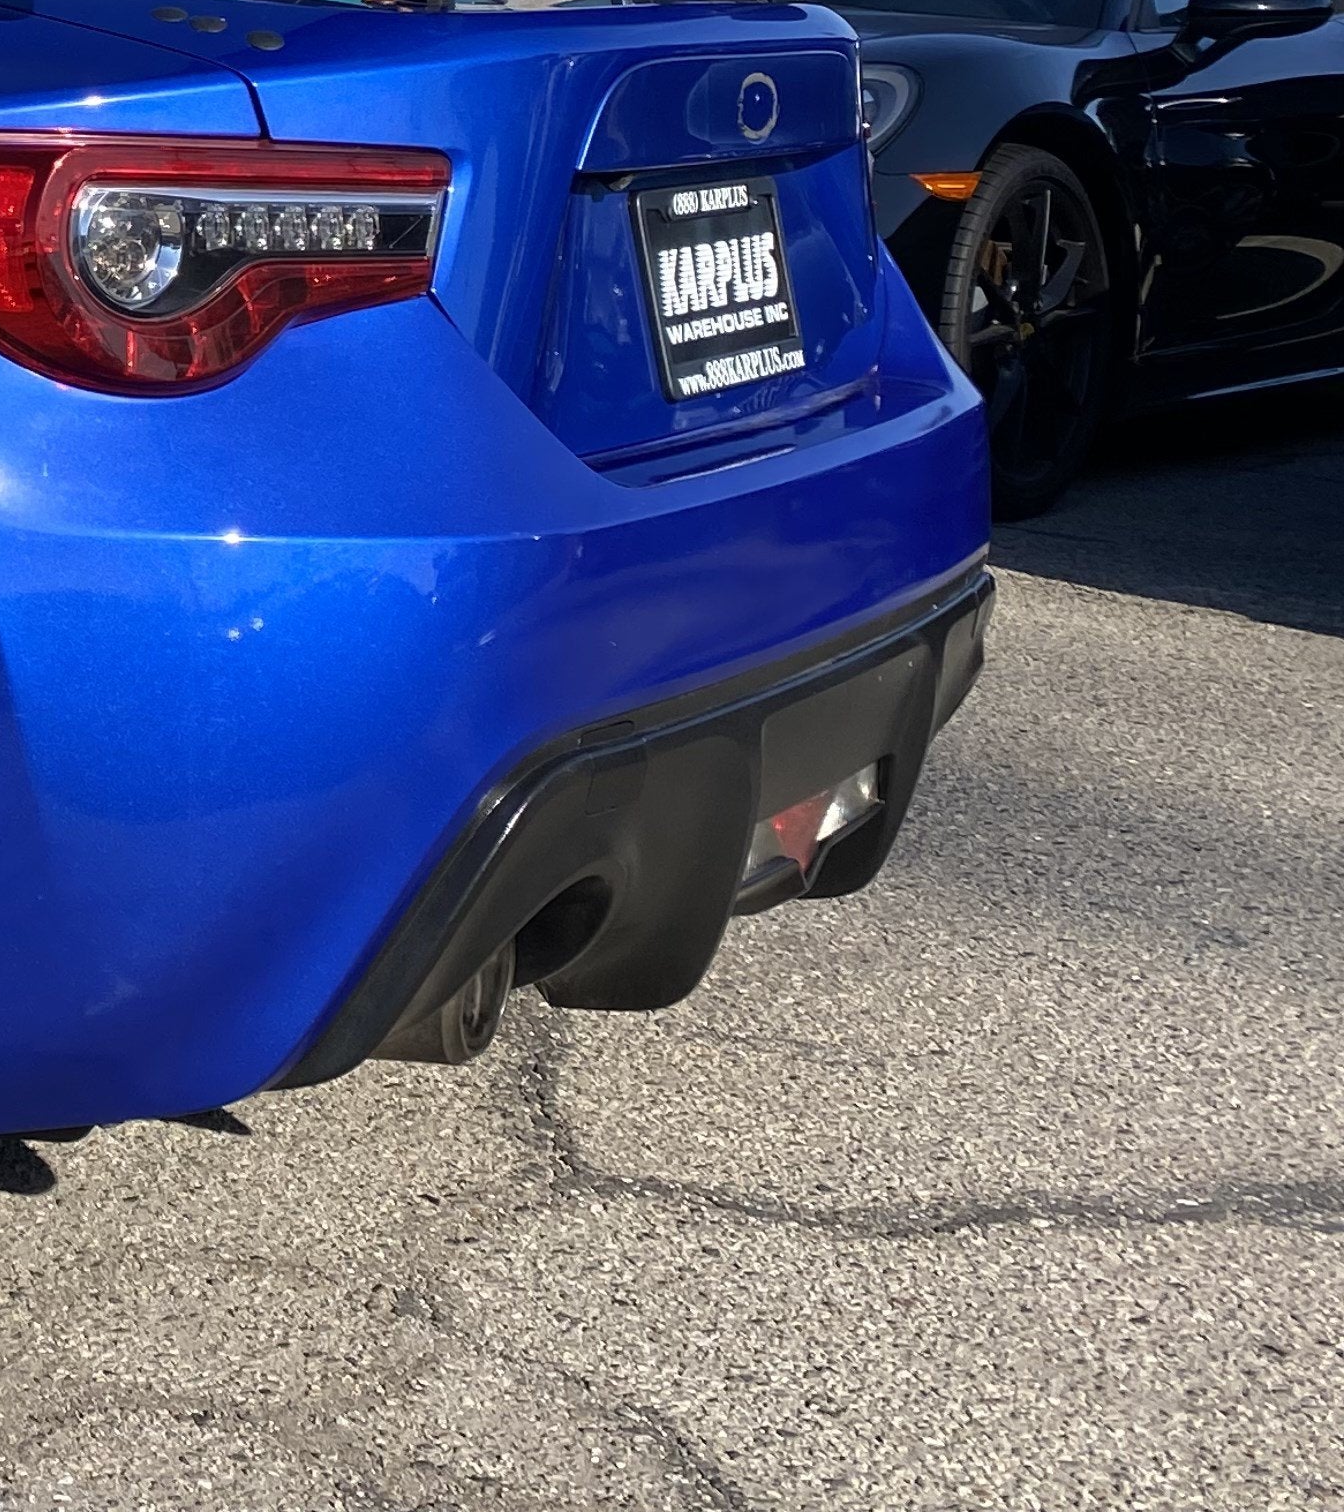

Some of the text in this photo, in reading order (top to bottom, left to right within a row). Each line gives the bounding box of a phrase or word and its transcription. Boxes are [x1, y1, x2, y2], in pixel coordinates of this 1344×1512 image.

[699, 185, 749, 211] KARPLUS
[657, 231, 780, 317] KARPLUS
[665, 302, 789, 345] WAREHOUSE INC
